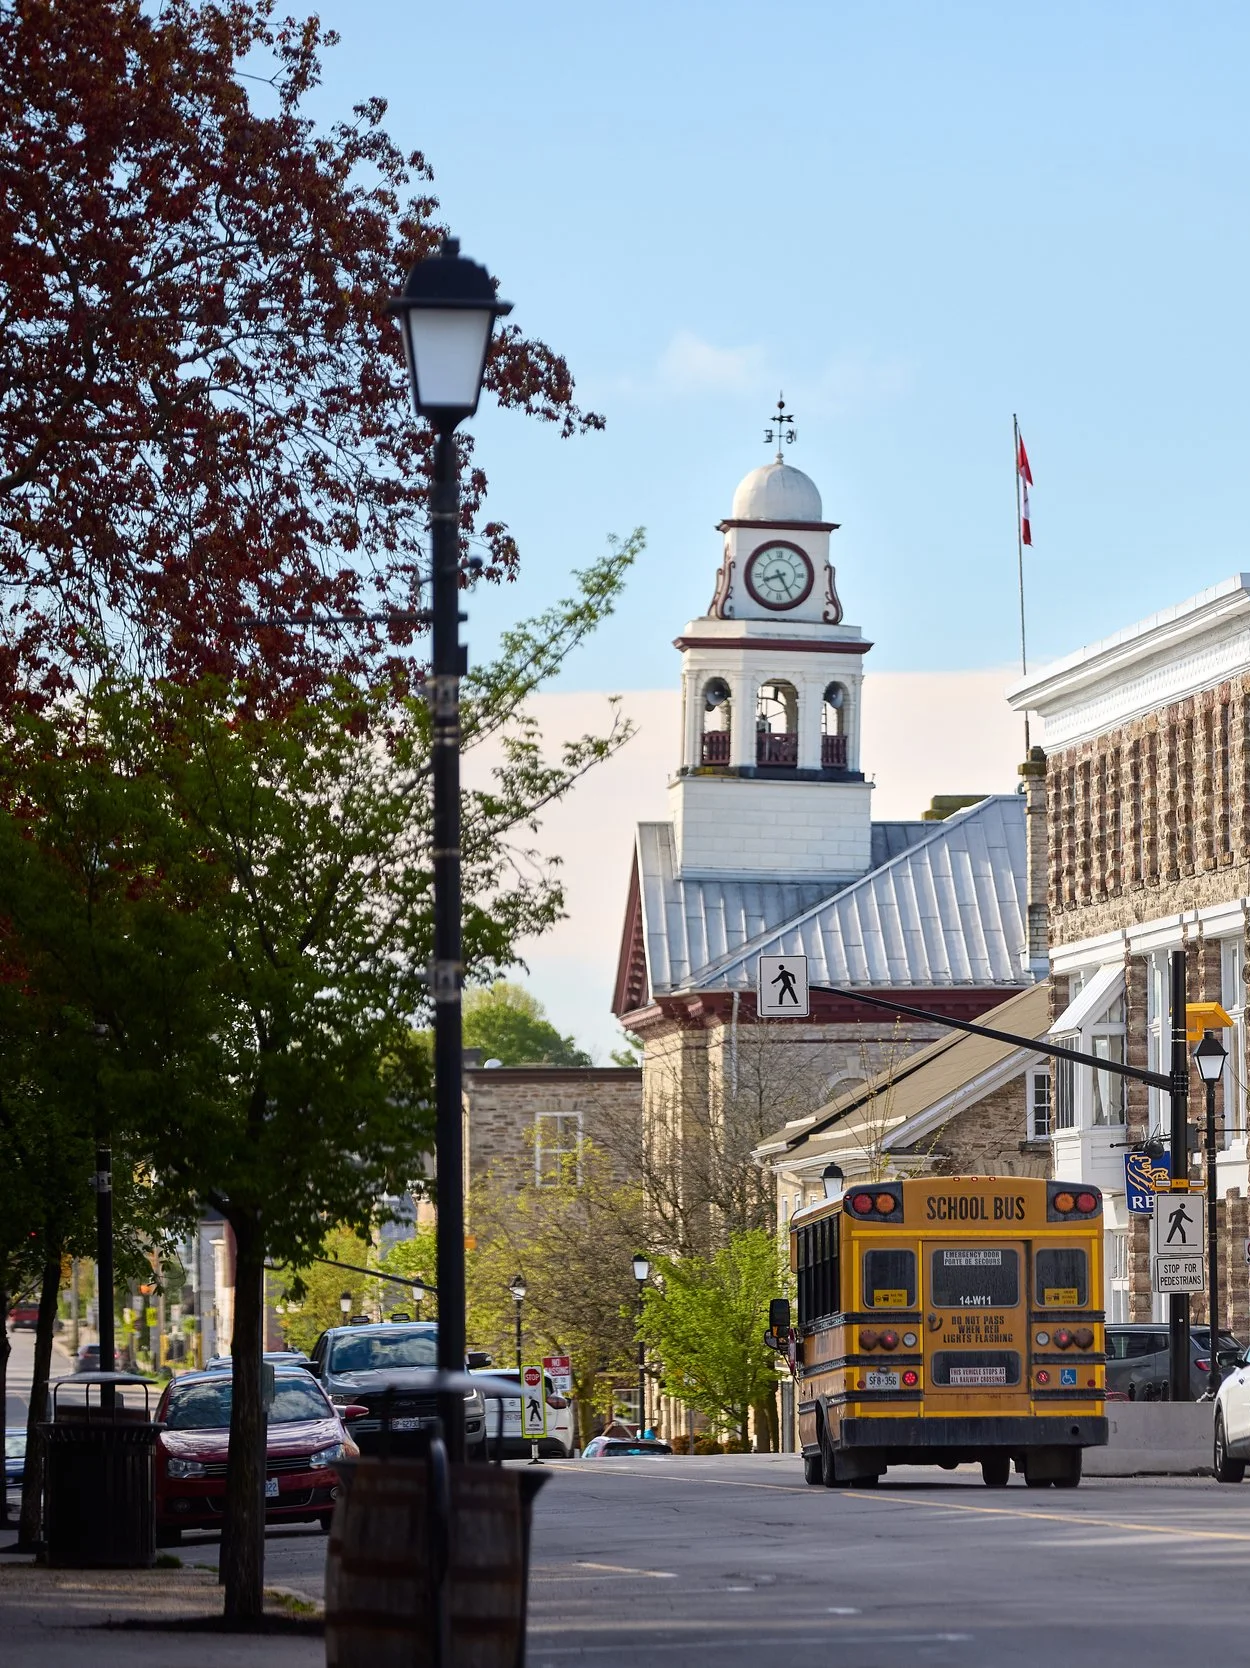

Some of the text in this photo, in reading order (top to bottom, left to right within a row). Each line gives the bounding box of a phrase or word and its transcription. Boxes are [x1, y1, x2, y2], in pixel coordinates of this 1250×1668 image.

[1132, 1196, 1154, 1208] RB
[926, 1196, 1025, 1220] SCHOOL BUS
[1164, 1264, 1197, 1273] STOP FOR
[1160, 1276, 1201, 1286] PEDESTRIANS
[960, 1296, 992, 1305] 14-W11
[952, 1316, 1004, 1324] DO NOT PASS
[958, 1325, 980, 1334] WHEN
[943, 1334, 1013, 1343] LIGHTS FLASHING
